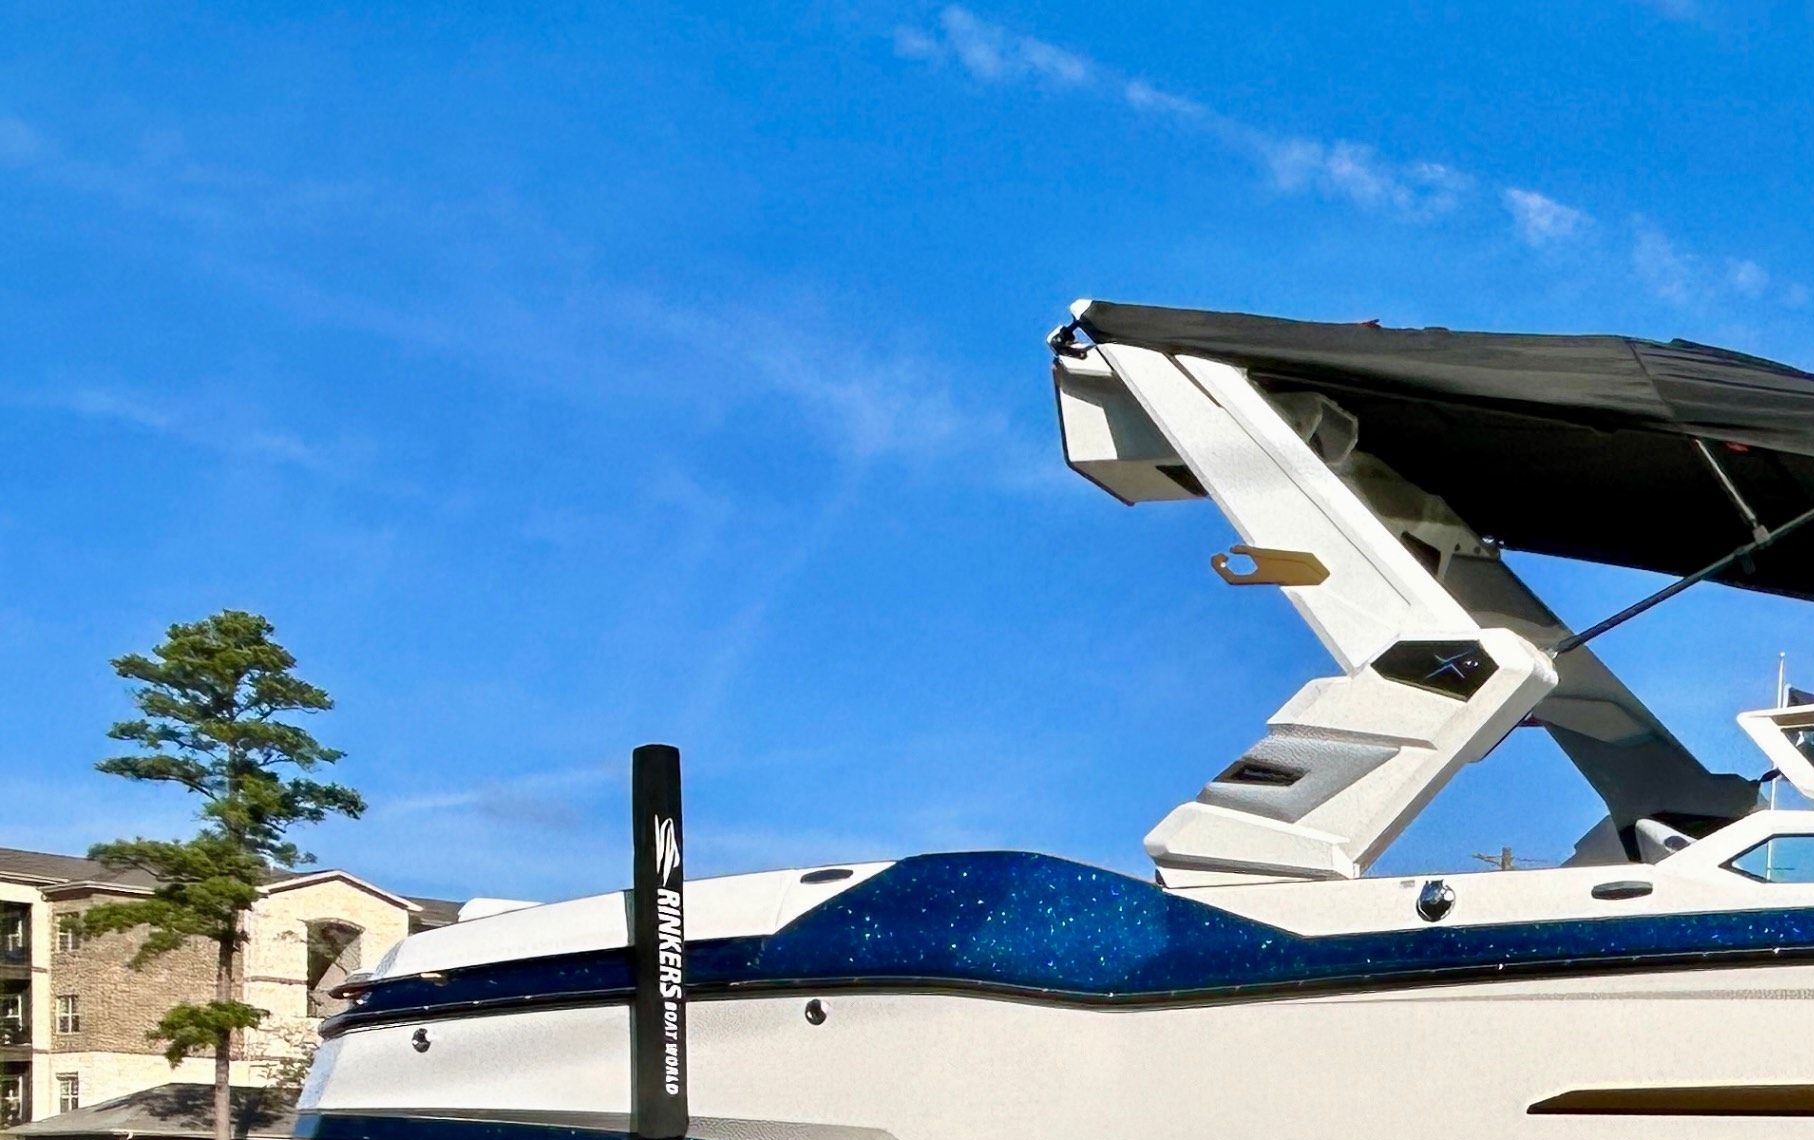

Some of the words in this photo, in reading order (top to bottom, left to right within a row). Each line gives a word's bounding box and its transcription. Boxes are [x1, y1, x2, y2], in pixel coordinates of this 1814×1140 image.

[656, 887, 682, 1000] RINKERS
[663, 1001, 679, 1038] BOAT
[664, 1042, 680, 1095] WORLD
